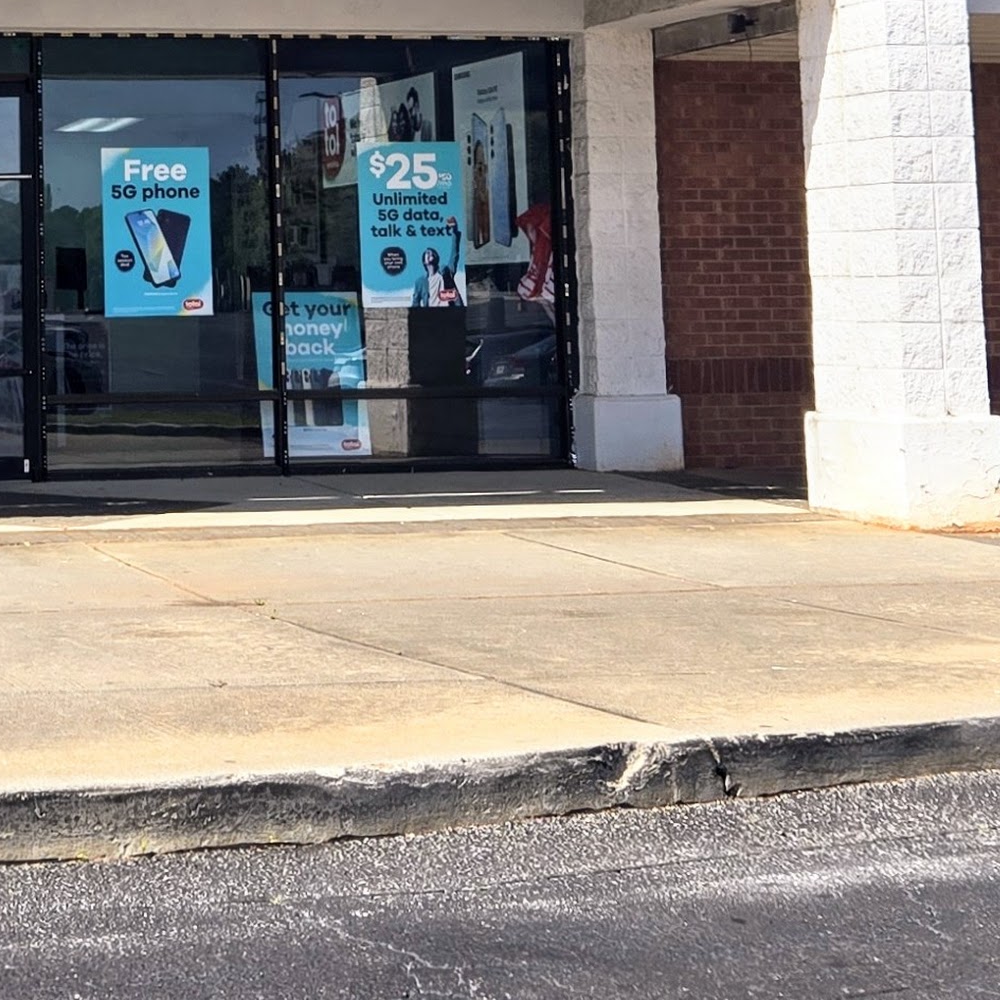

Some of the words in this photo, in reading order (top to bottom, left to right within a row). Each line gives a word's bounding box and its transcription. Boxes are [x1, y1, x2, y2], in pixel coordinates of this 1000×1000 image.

[124, 159, 187, 182] Free
[369, 150, 438, 190] $25
[111, 184, 137, 199] 5G
[142, 183, 200, 202] phone
[372, 192, 448, 206] Unlimited
[378, 210, 399, 221] 5G
[402, 209, 444, 223] data,
[370, 224, 402, 238] talk
[405, 224, 417, 237] &
[420, 224, 454, 237] text
[305, 303, 351, 320] your
[285, 322, 343, 339] oney
[285, 338, 336, 355] back
